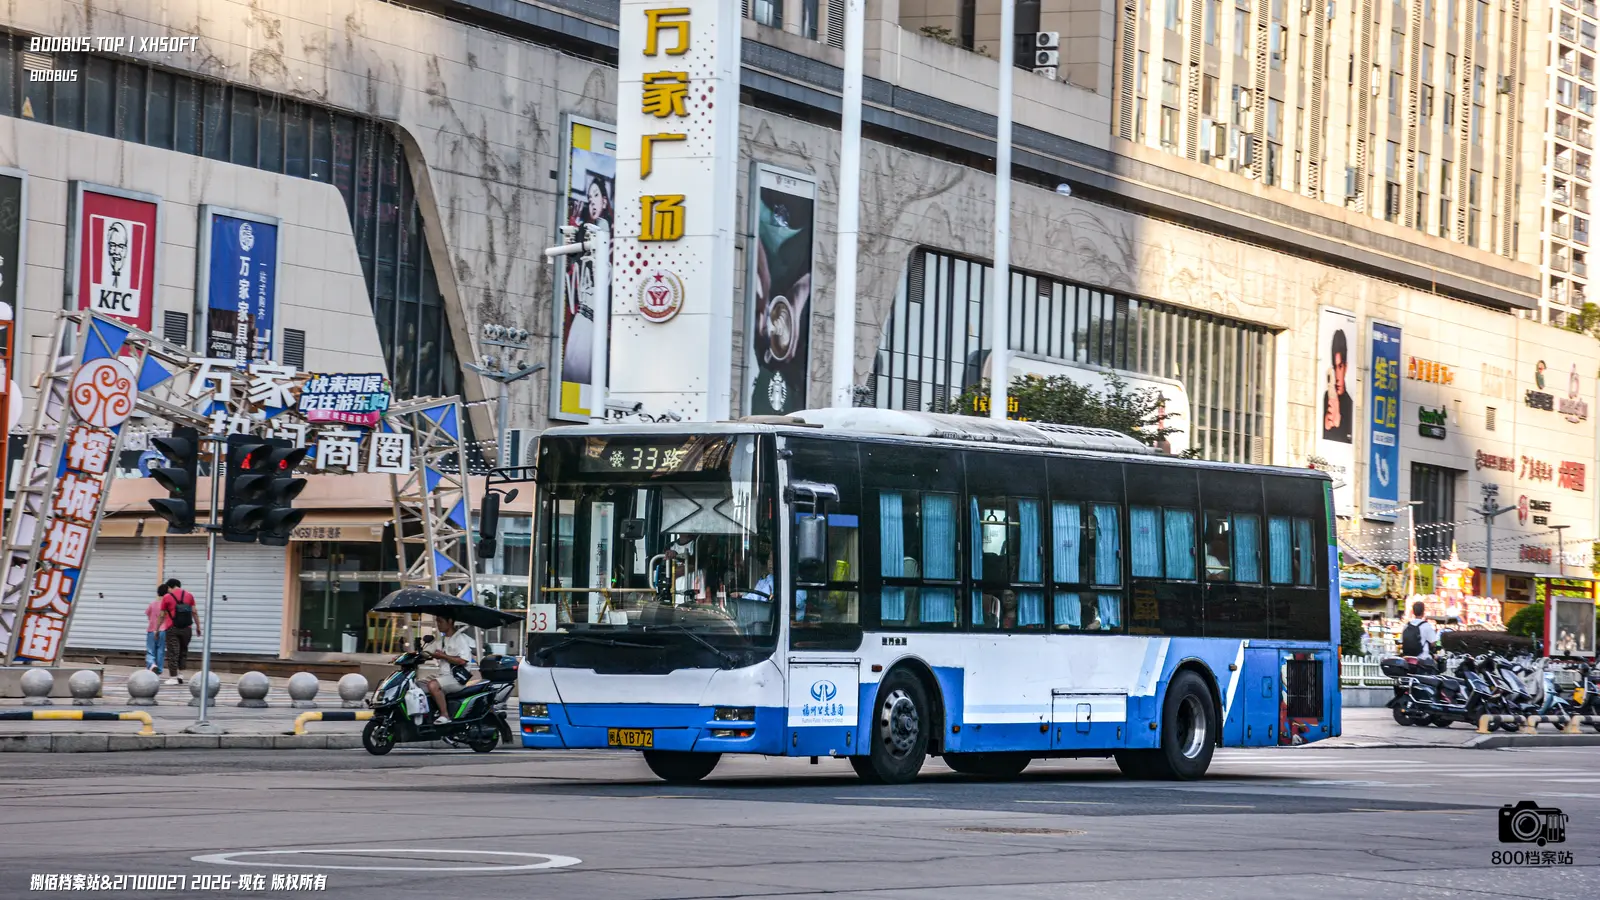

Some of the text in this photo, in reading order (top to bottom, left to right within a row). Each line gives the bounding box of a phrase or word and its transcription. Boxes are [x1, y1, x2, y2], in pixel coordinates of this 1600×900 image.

[638, 7, 691, 241] 万家广场
[98, 288, 133, 312] KFC
[235, 255, 251, 370] 万家家具建
[187, 355, 298, 409] 万家
[310, 375, 382, 393] 快来闽侯
[299, 393, 389, 411] 吃住游乐购
[631, 447, 689, 469] 33路
[18, 426, 112, 661] 榕城烟火街
[530, 612, 548, 631] 33
[802, 703, 844, 716] 福州公交集团
